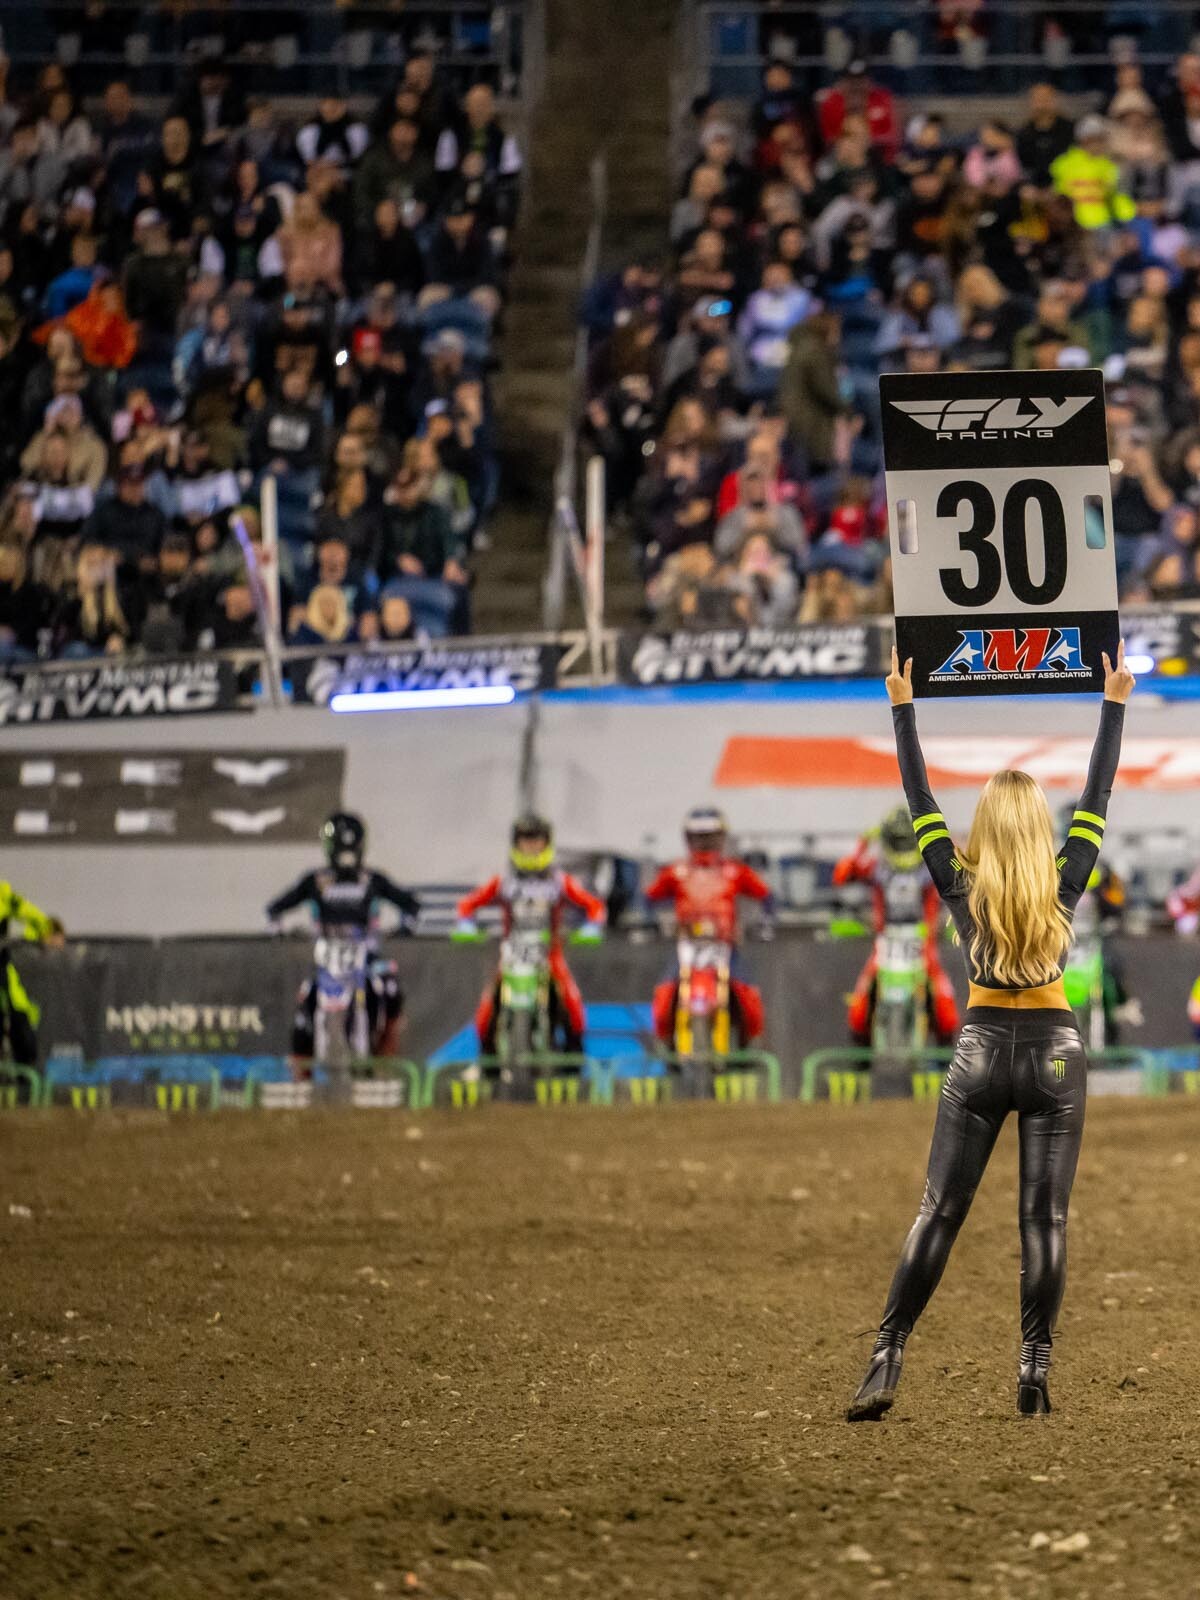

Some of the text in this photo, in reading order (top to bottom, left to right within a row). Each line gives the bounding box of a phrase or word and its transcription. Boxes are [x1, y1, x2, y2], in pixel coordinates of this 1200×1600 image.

[889, 396, 1096, 430] FLY
[936, 429, 1054, 441] RACING
[936, 478, 1068, 607] 30
[929, 627, 1092, 675] AMA
[929, 671, 1093, 682] AMERICAN MOTORCYCLIST ASSOCIATION
